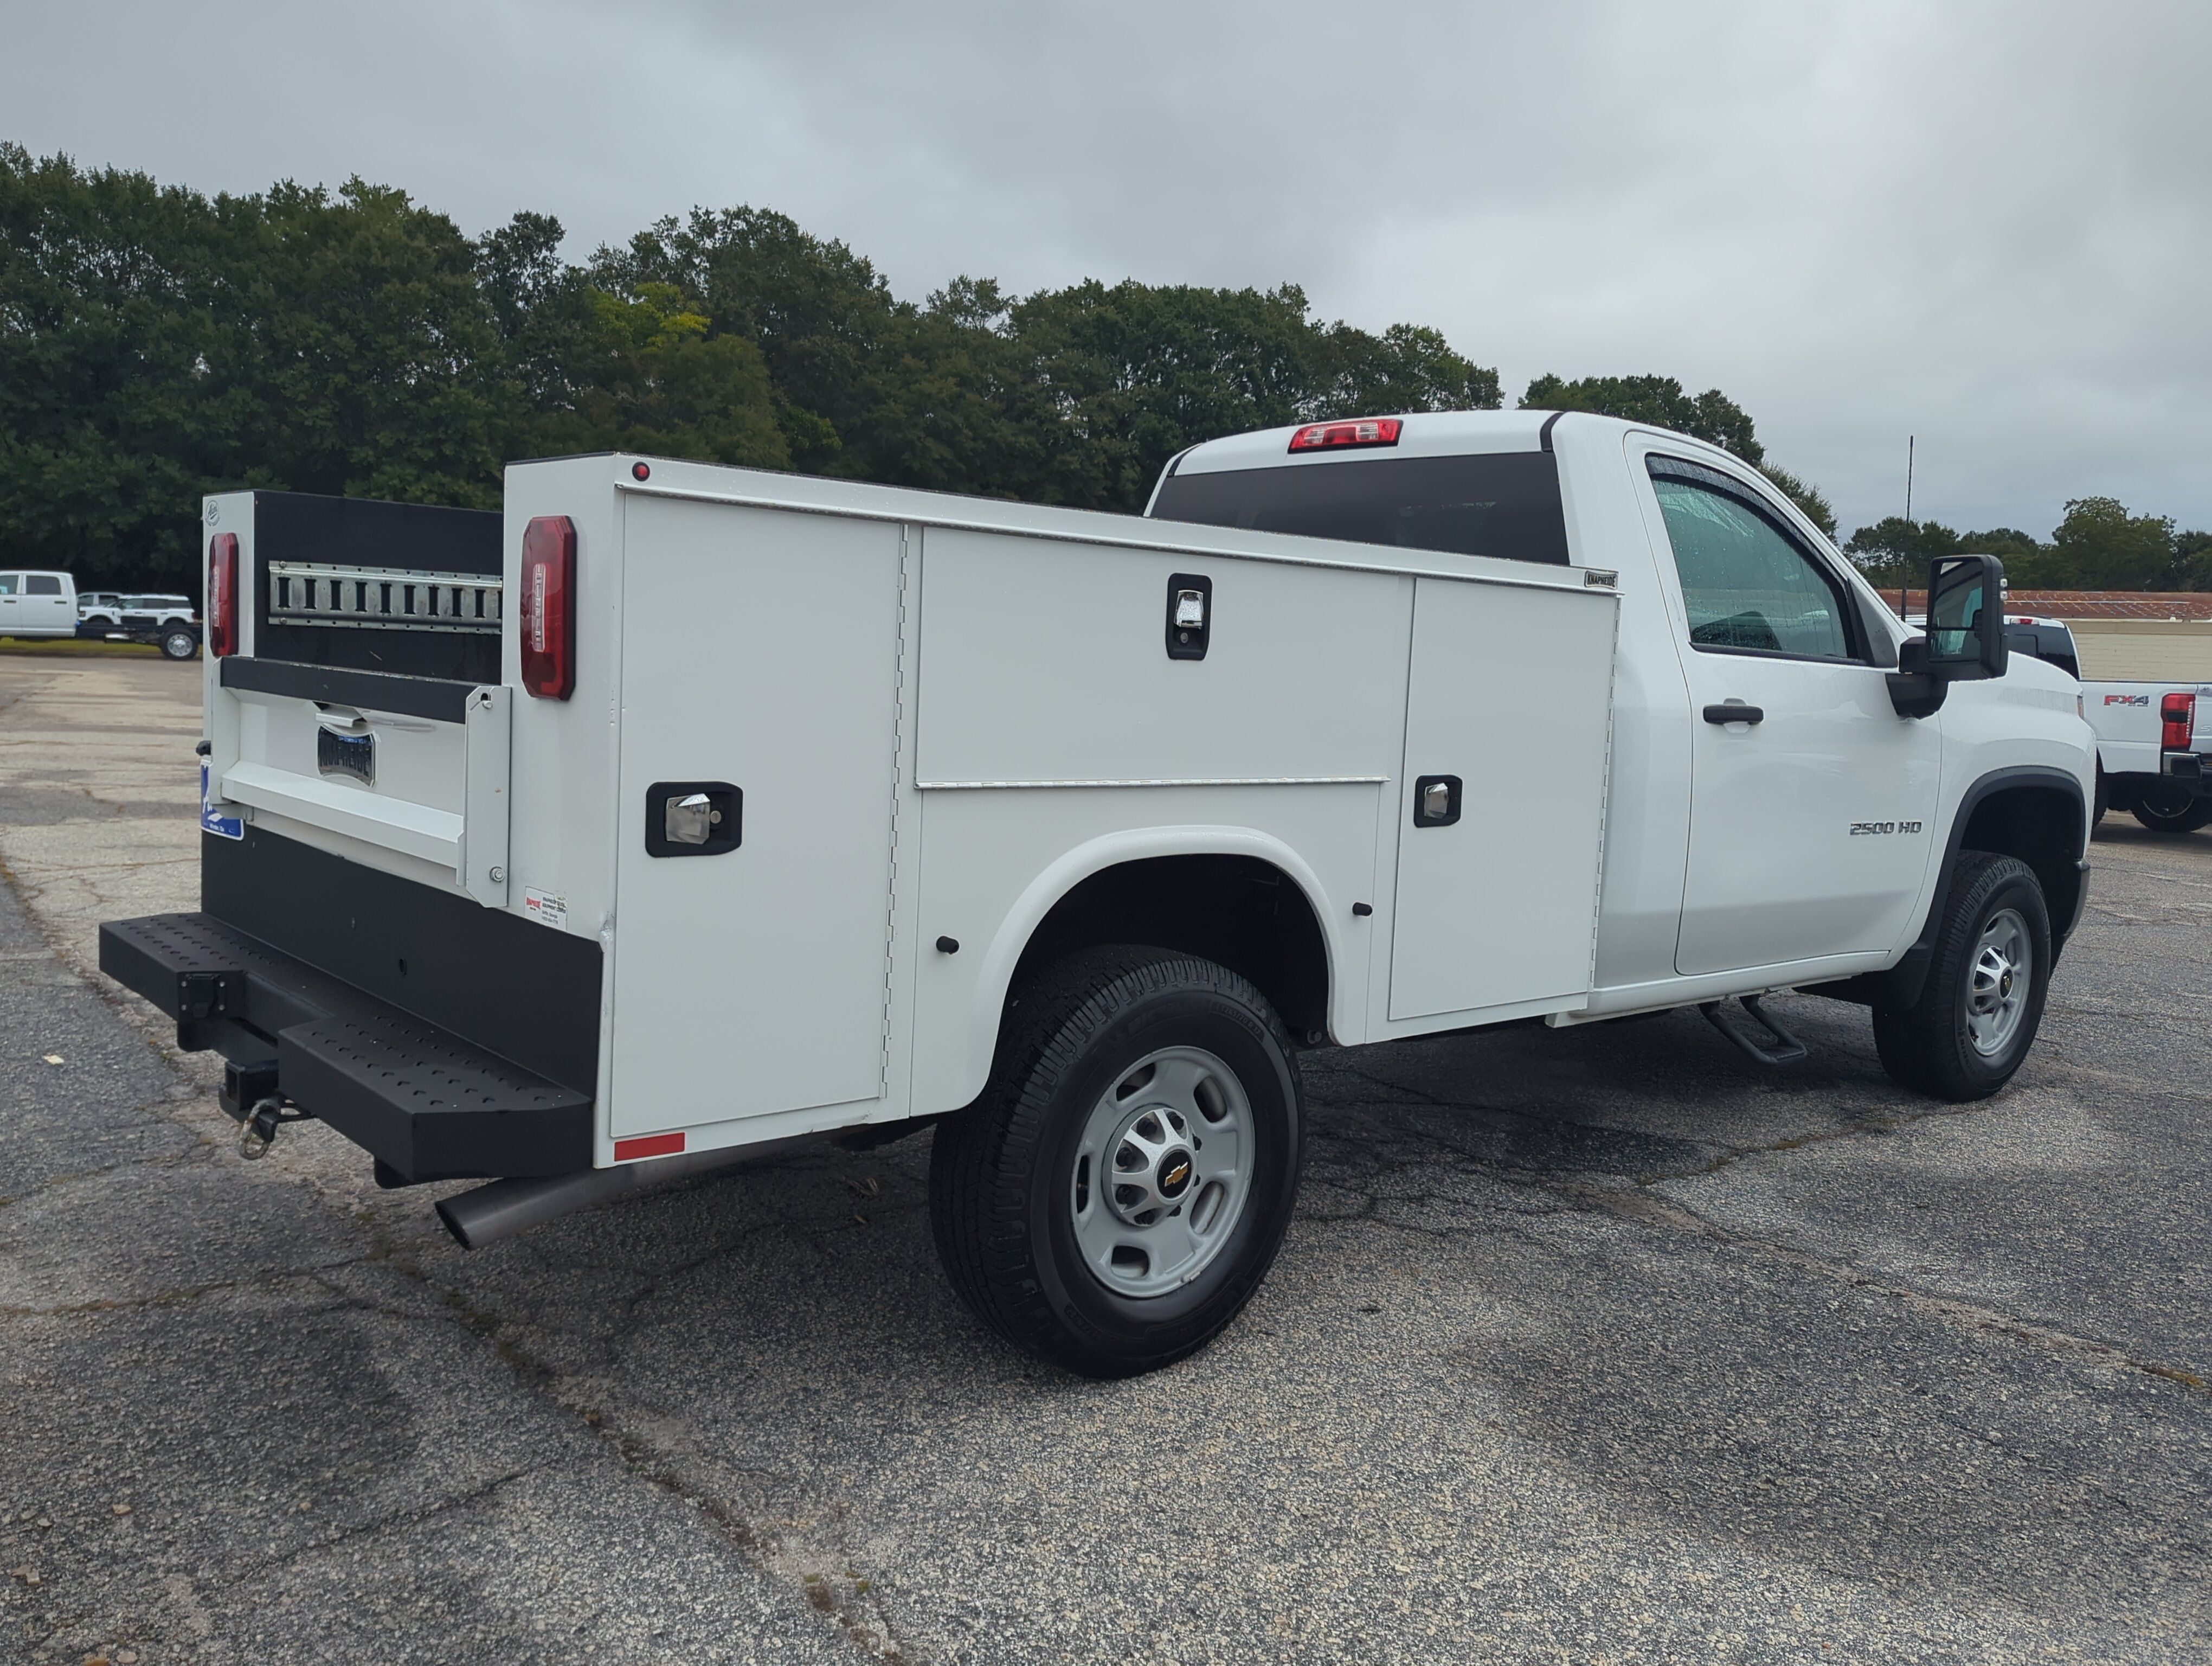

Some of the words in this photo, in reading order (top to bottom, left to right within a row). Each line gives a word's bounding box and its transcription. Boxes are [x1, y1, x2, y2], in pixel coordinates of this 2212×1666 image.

[1587, 573, 1616, 587] KNAPHEIDE
[2104, 695, 2149, 706] FX4
[1850, 822, 1894, 835] 2500
[1898, 821, 1922, 834] HD
